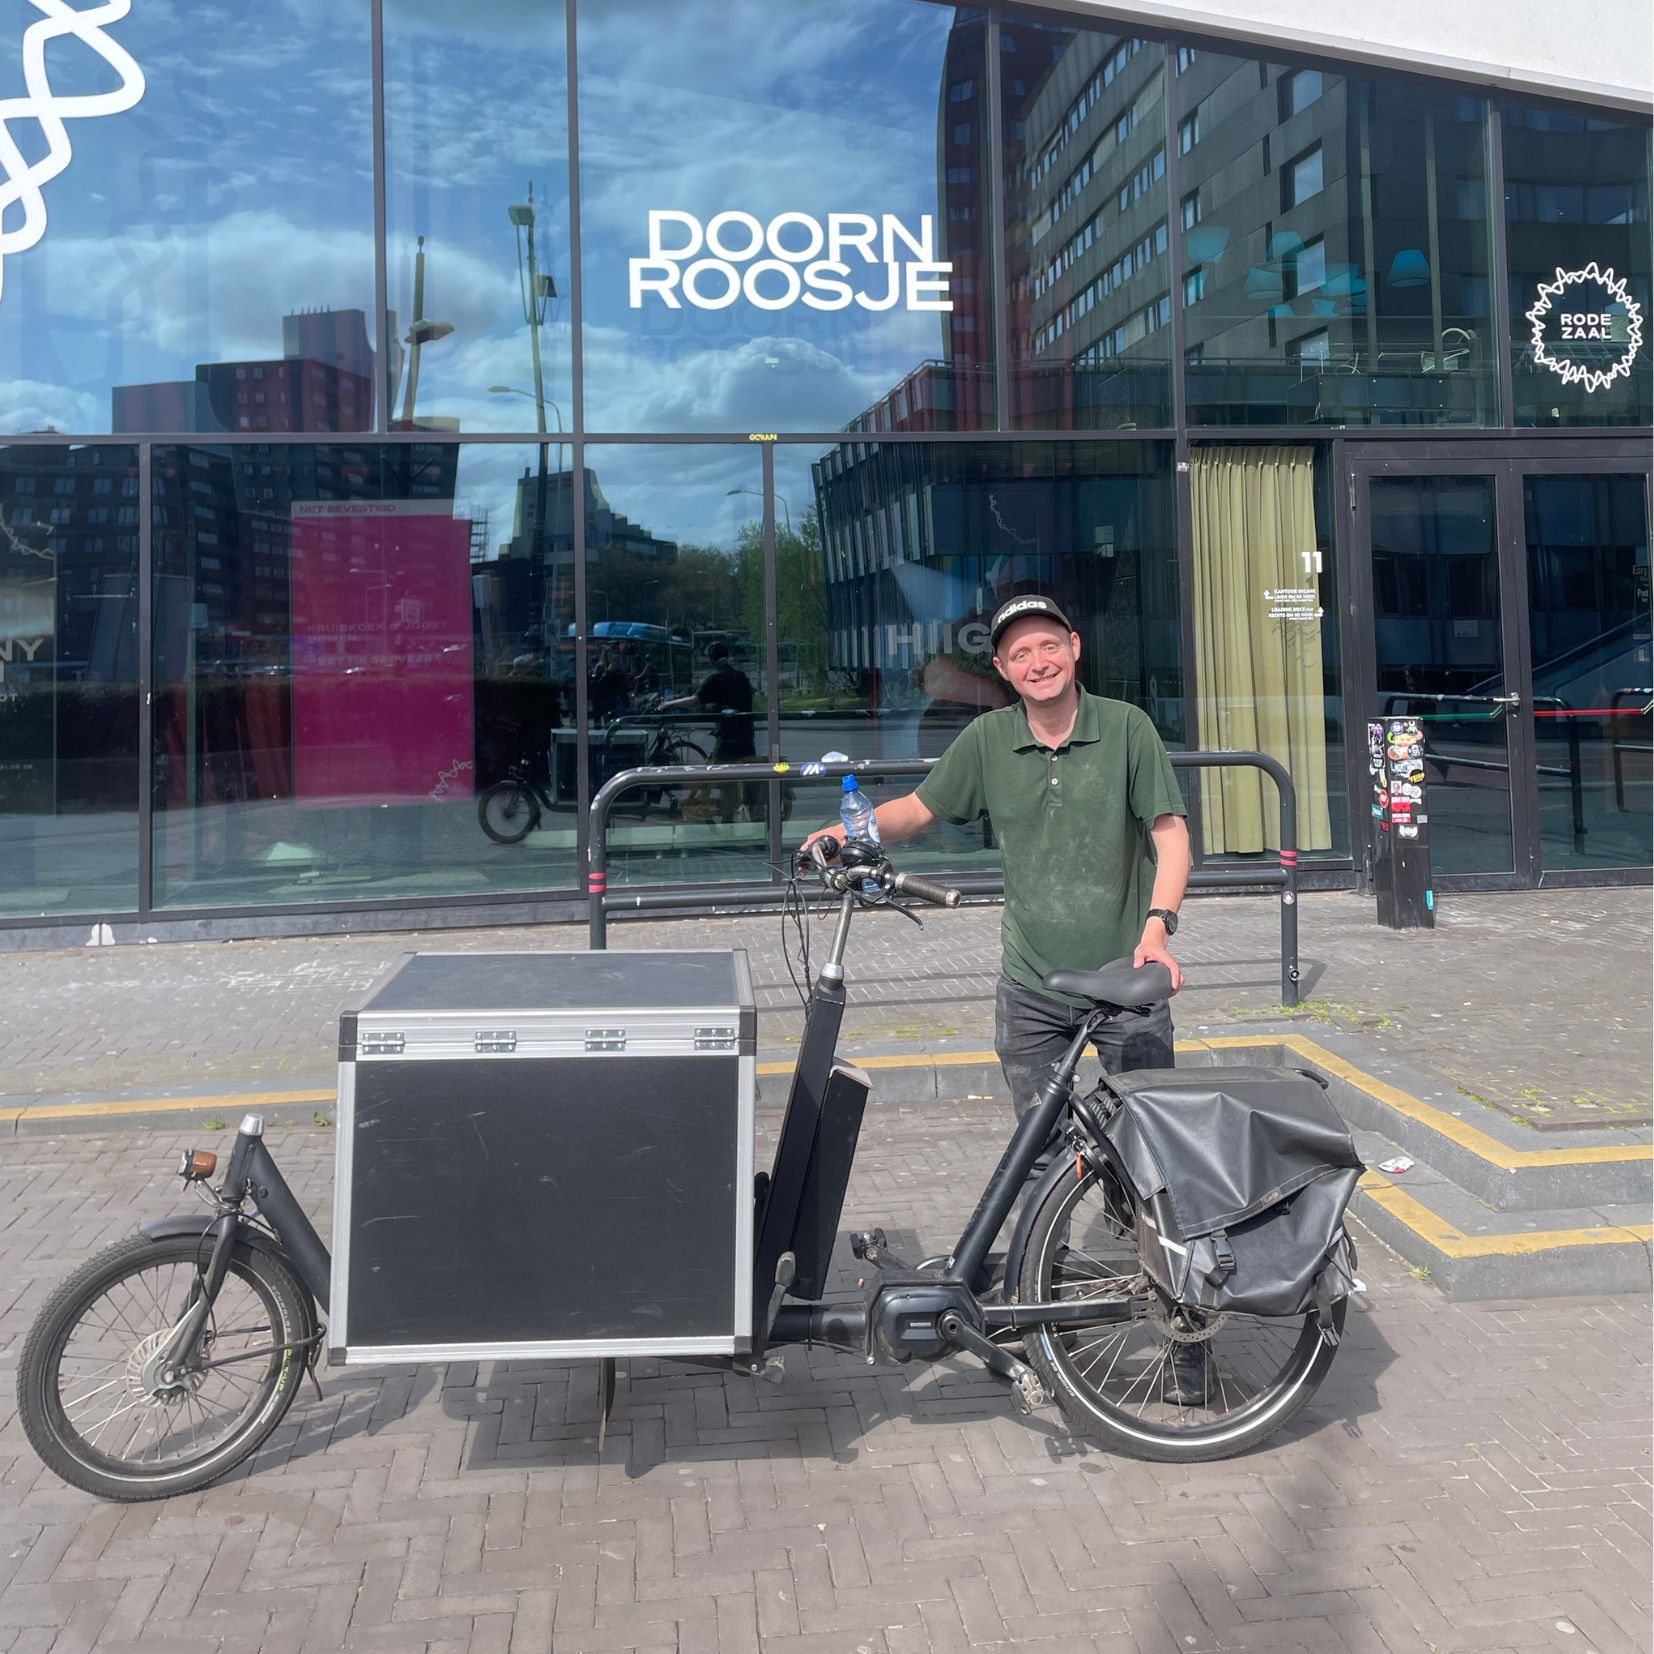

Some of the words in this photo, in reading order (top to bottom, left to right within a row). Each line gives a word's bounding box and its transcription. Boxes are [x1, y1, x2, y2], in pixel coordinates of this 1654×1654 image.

[648, 210, 933, 263] DOORN
[628, 258, 954, 311] ROOSJE
[1560, 313, 1612, 326] RODE
[1561, 327, 1612, 339] ZAAL
[1301, 551, 1323, 573] 11
[997, 600, 1048, 624] adidas
